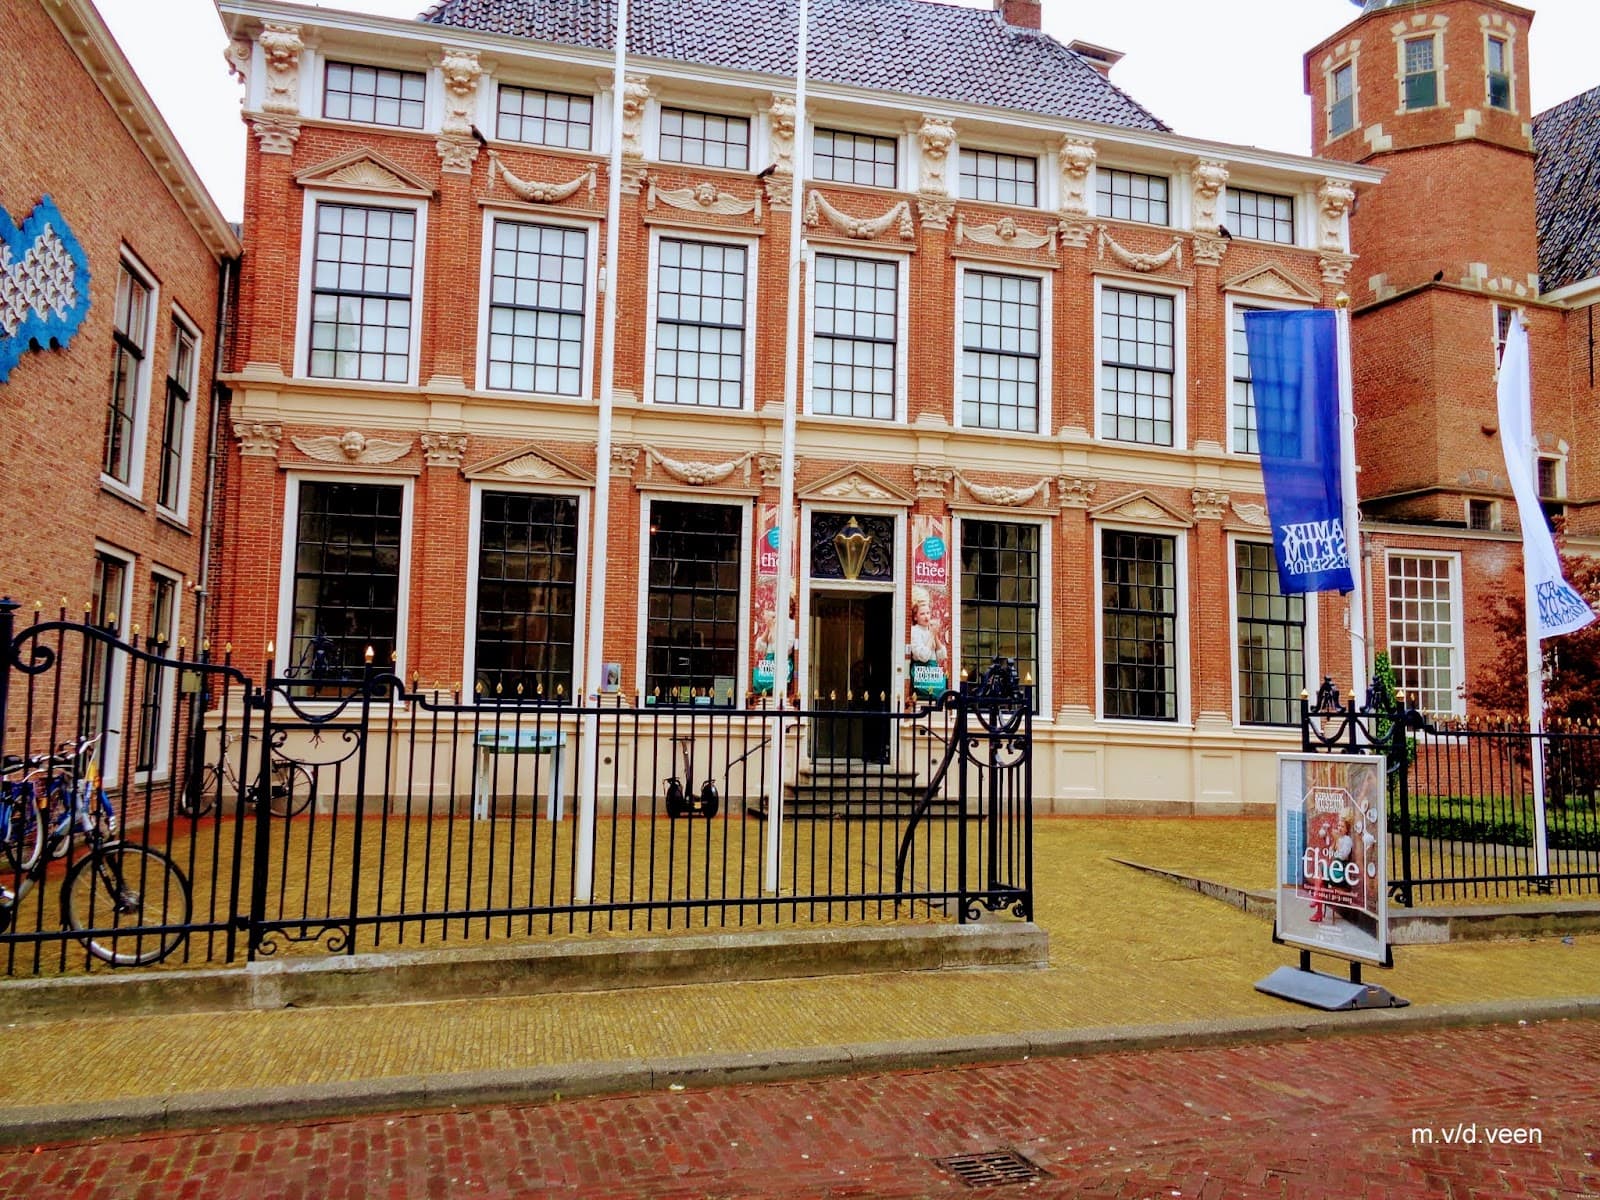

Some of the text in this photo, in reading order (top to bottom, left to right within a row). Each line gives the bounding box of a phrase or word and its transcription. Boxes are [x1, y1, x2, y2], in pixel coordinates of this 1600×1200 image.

[761, 552, 778, 567] th
[916, 561, 945, 577] thee
[1301, 847, 1360, 886] thee
